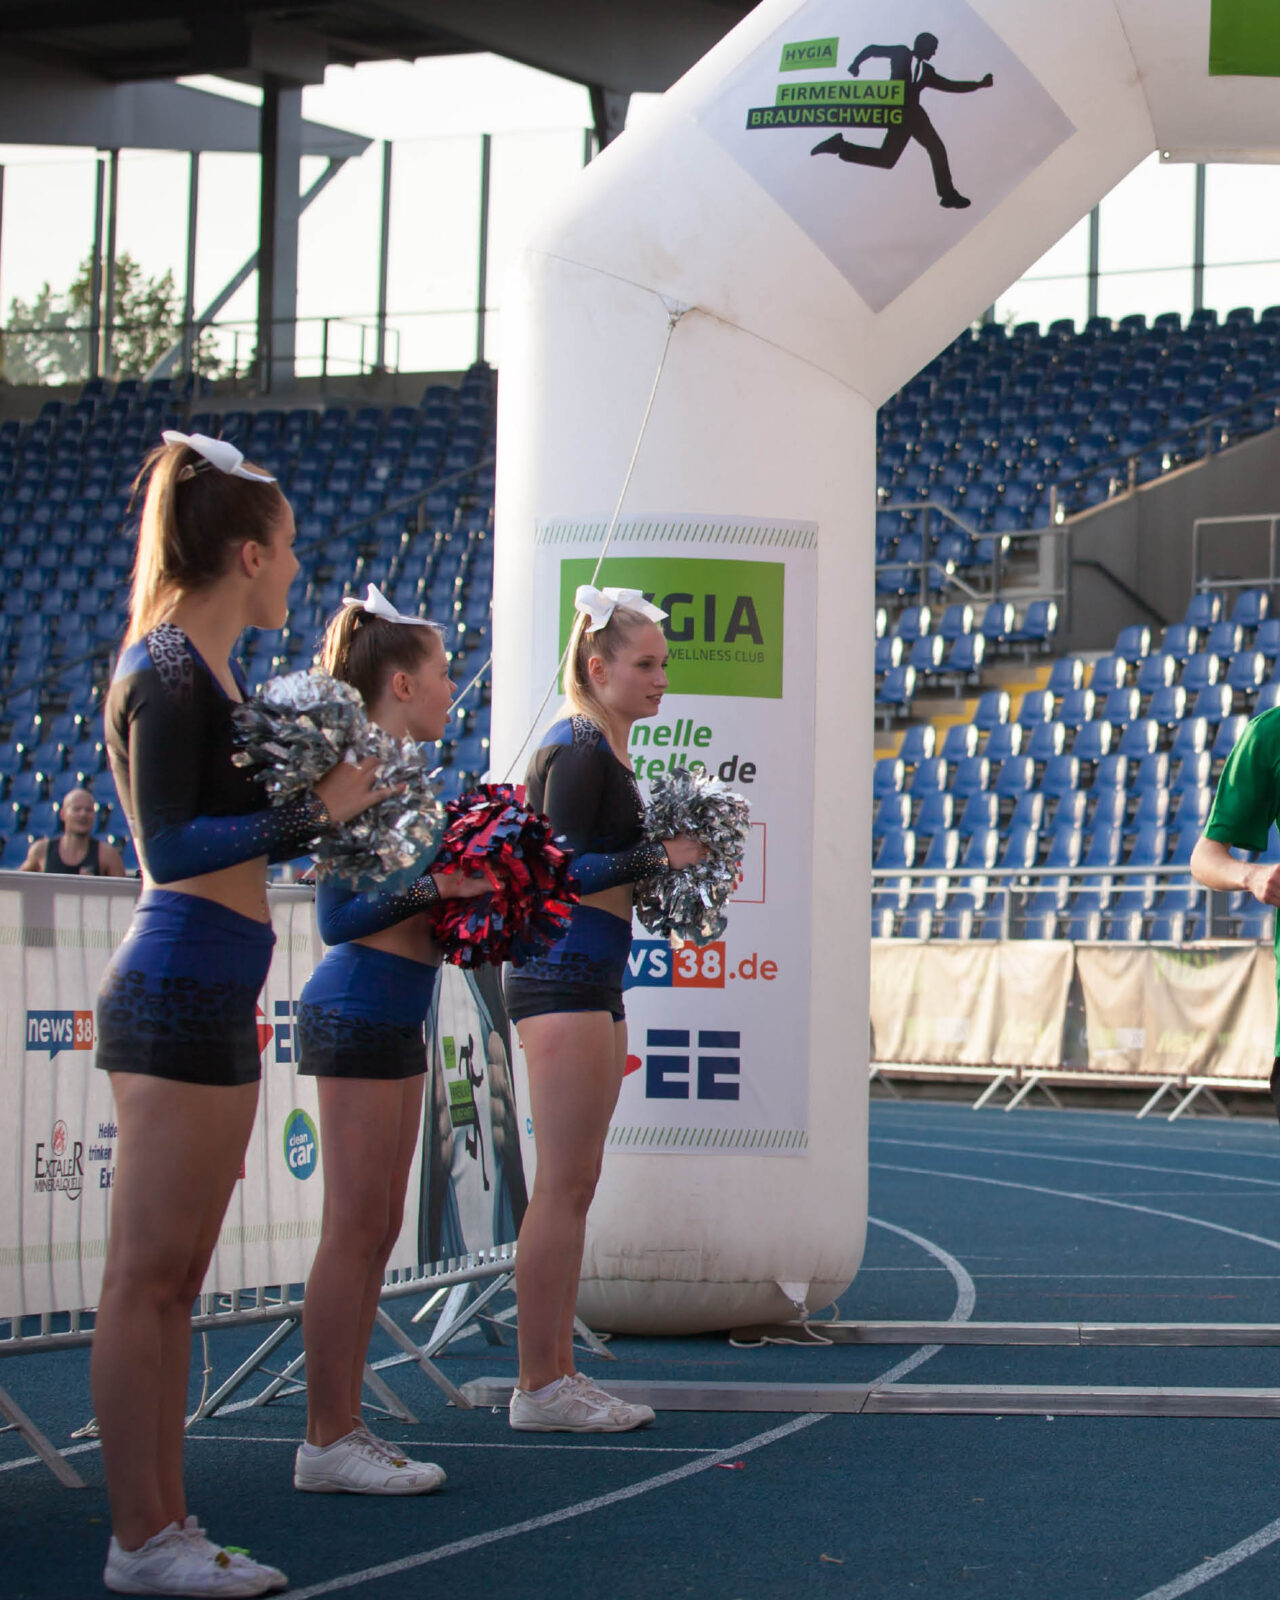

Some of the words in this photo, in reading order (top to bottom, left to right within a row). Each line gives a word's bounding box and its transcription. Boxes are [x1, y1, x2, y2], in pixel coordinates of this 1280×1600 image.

[785, 45, 832, 61] HYGIA
[781, 85, 900, 101] FIRMENLAUF
[750, 107, 904, 126] BRAUNSCHWEIG
[643, 592, 764, 645] GIA
[734, 651, 765, 663] CLUB
[630, 718, 713, 748] nelle
[27, 1016, 98, 1044] news38.
[98, 1122, 119, 1139] Helde
[289, 1134, 308, 1147] clean
[288, 1143, 314, 1168] car
[99, 1167, 115, 1189] Ex!
